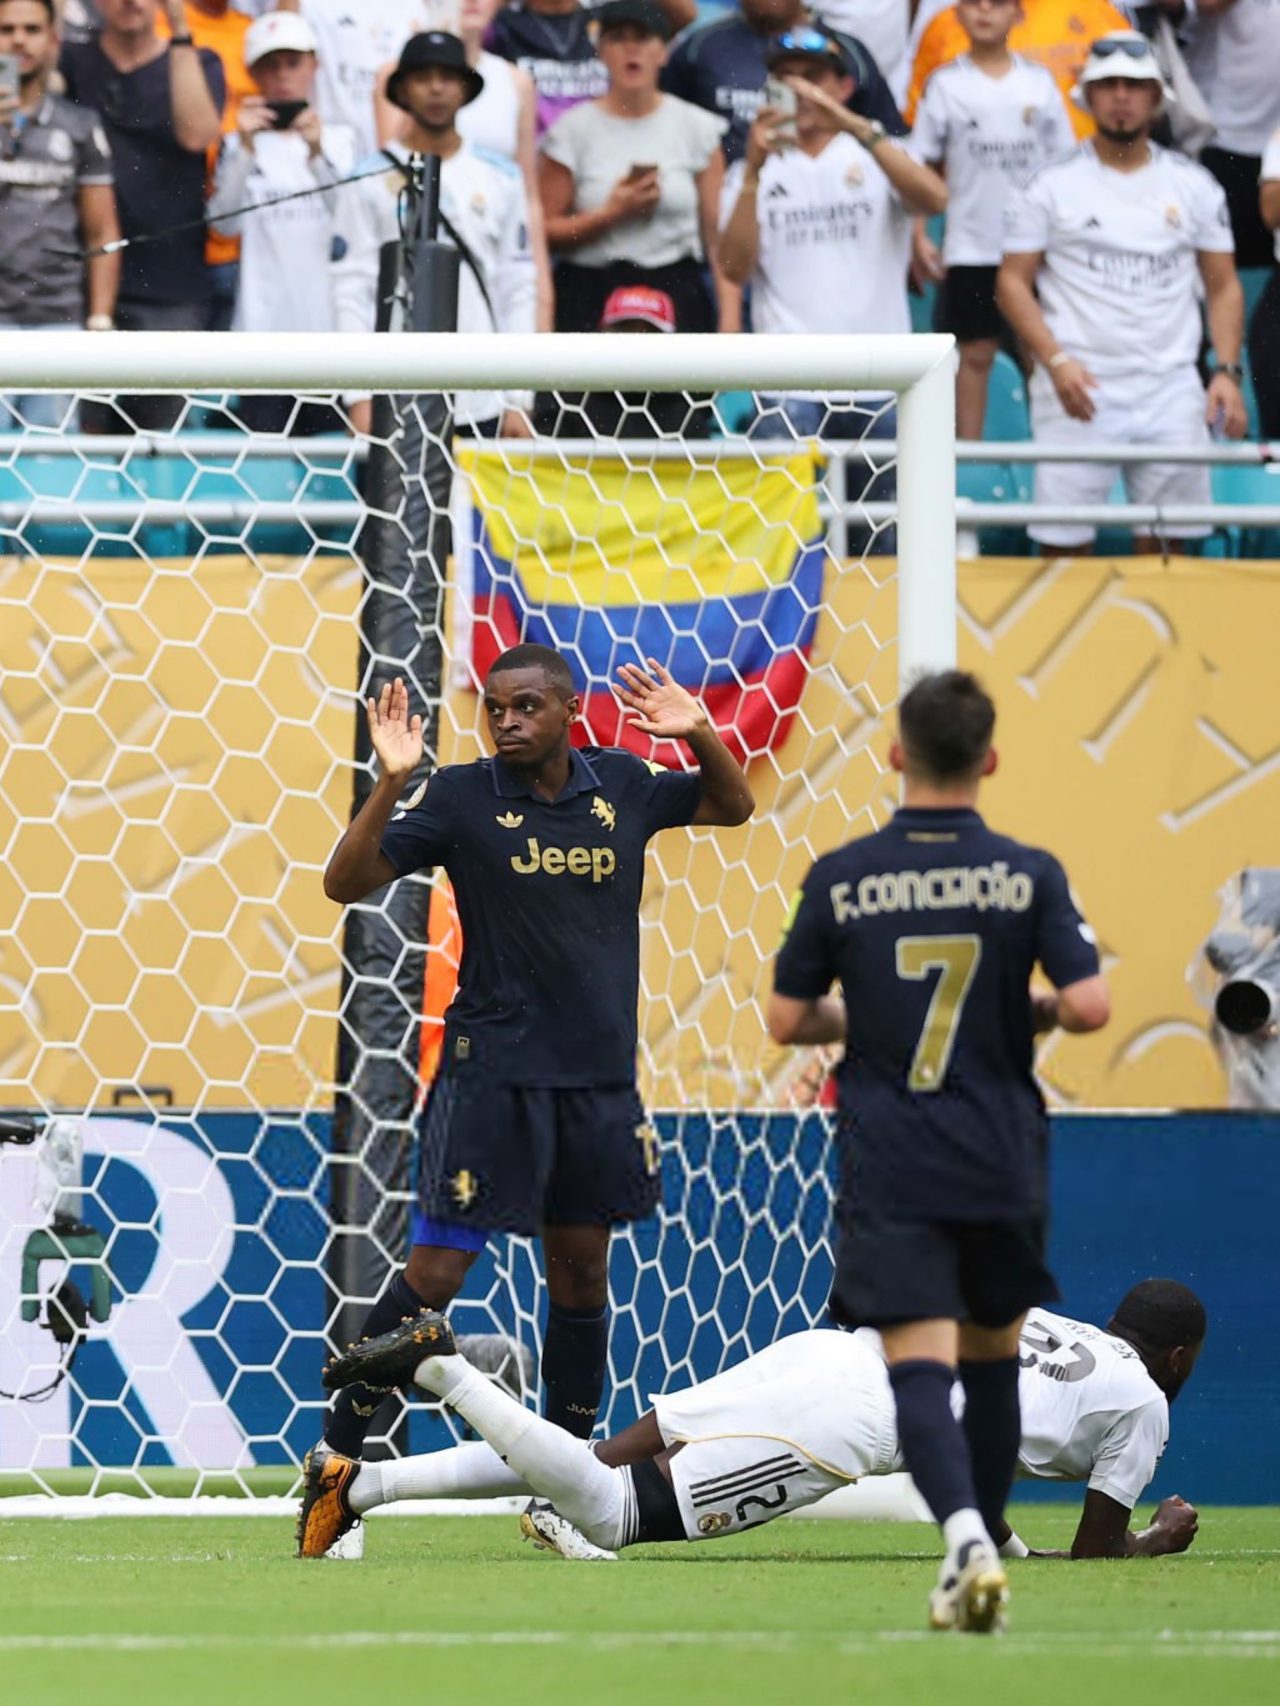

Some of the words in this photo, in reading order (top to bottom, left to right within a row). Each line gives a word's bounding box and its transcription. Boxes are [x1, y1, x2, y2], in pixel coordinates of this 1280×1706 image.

[768, 201, 873, 231] Emirates
[510, 838, 616, 883] Jeep
[830, 861, 1034, 924] F.CONCEIÇÃO
[895, 933, 983, 1092] 7
